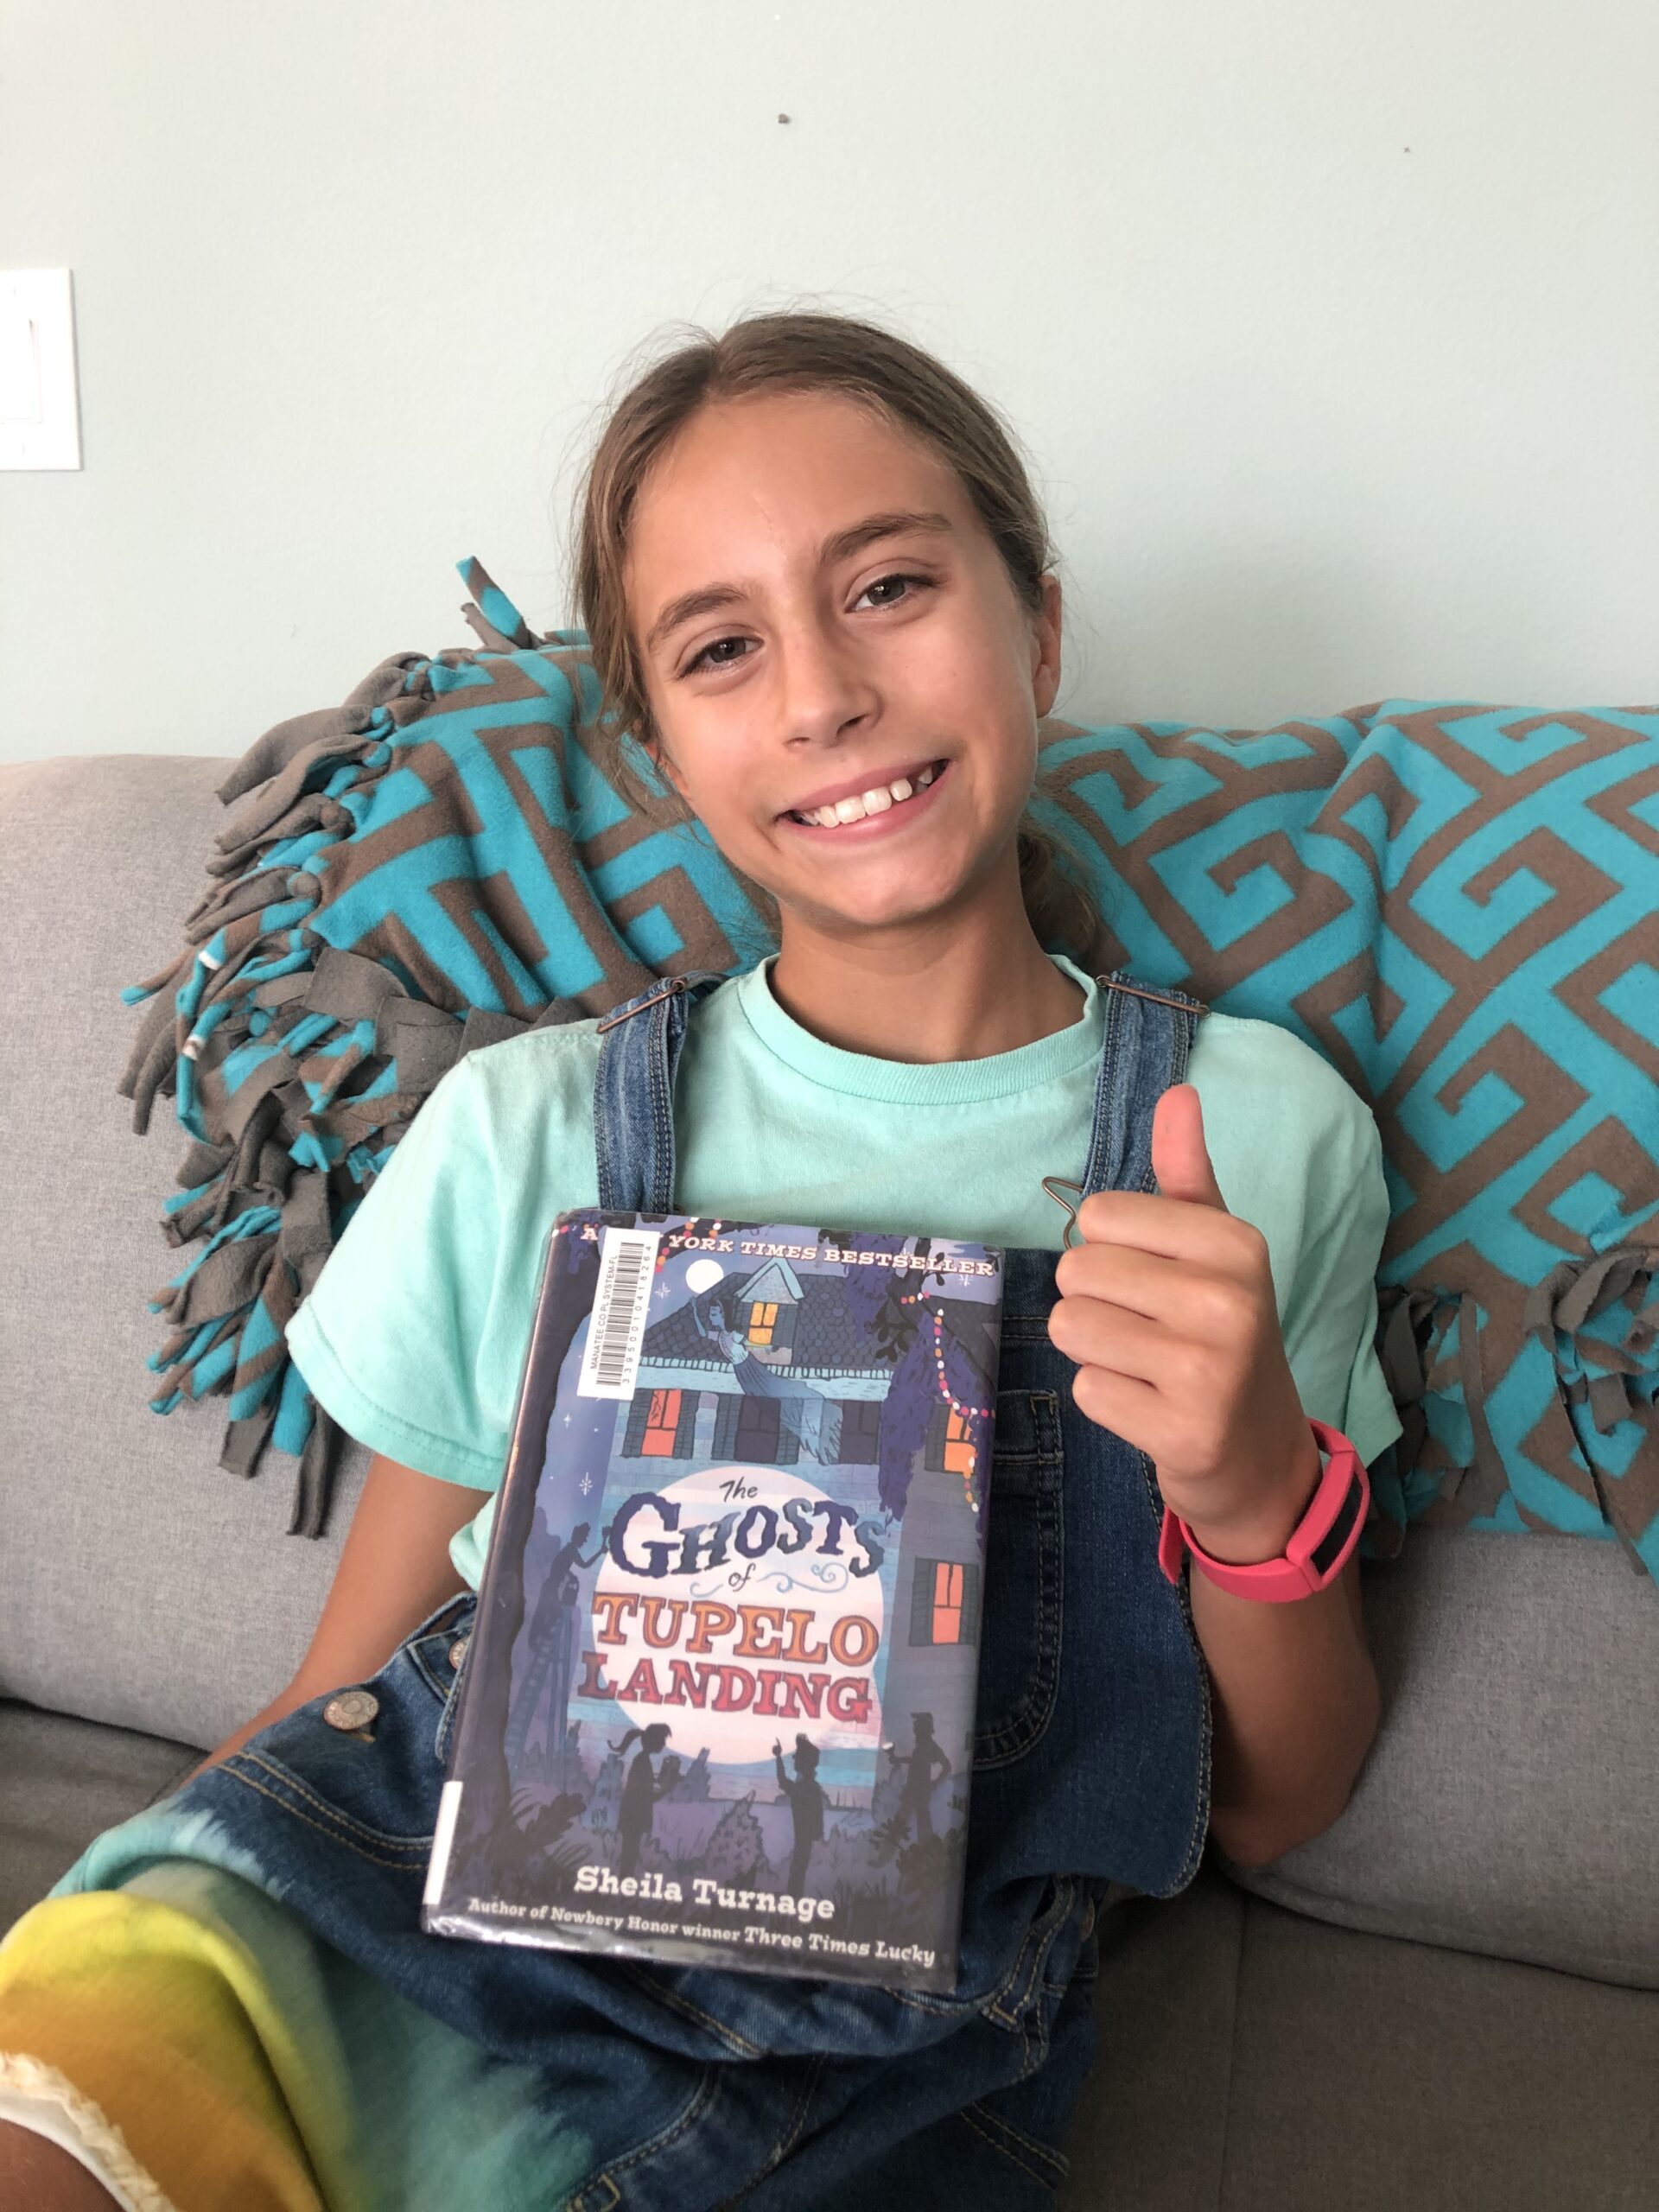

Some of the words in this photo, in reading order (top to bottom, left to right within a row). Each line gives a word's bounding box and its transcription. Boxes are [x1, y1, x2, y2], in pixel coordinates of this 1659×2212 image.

[580, 1227, 599, 1241] A
[669, 1235, 734, 1253] YORK
[741, 1242, 818, 1262] TIMES
[823, 1249, 995, 1277] BESTSELLER
[602, 1255, 618, 1300] SYSTEM-FL
[597, 1313, 607, 1326] CO
[600, 1302, 610, 1312] PL
[590, 1329, 604, 1370] MANATEE
[719, 1477, 759, 1503] The
[609, 1491, 886, 1580] GHOSTS
[728, 1562, 757, 1592] of
[591, 1591, 880, 1668] TUPELO
[577, 1650, 873, 1724] LANDING
[574, 1866, 683, 1903] Sheila
[692, 1878, 836, 1923] Turnage
[467, 1897, 527, 1918] Author
[530, 1905, 549, 1920] of
[550, 1907, 625, 1929] Newbery
[627, 1916, 678, 1934] Honor
[682, 1923, 741, 1942] winner
[744, 1925, 803, 1948] Three
[808, 1933, 870, 1956] Times
[874, 1941, 936, 1968] Lucky
